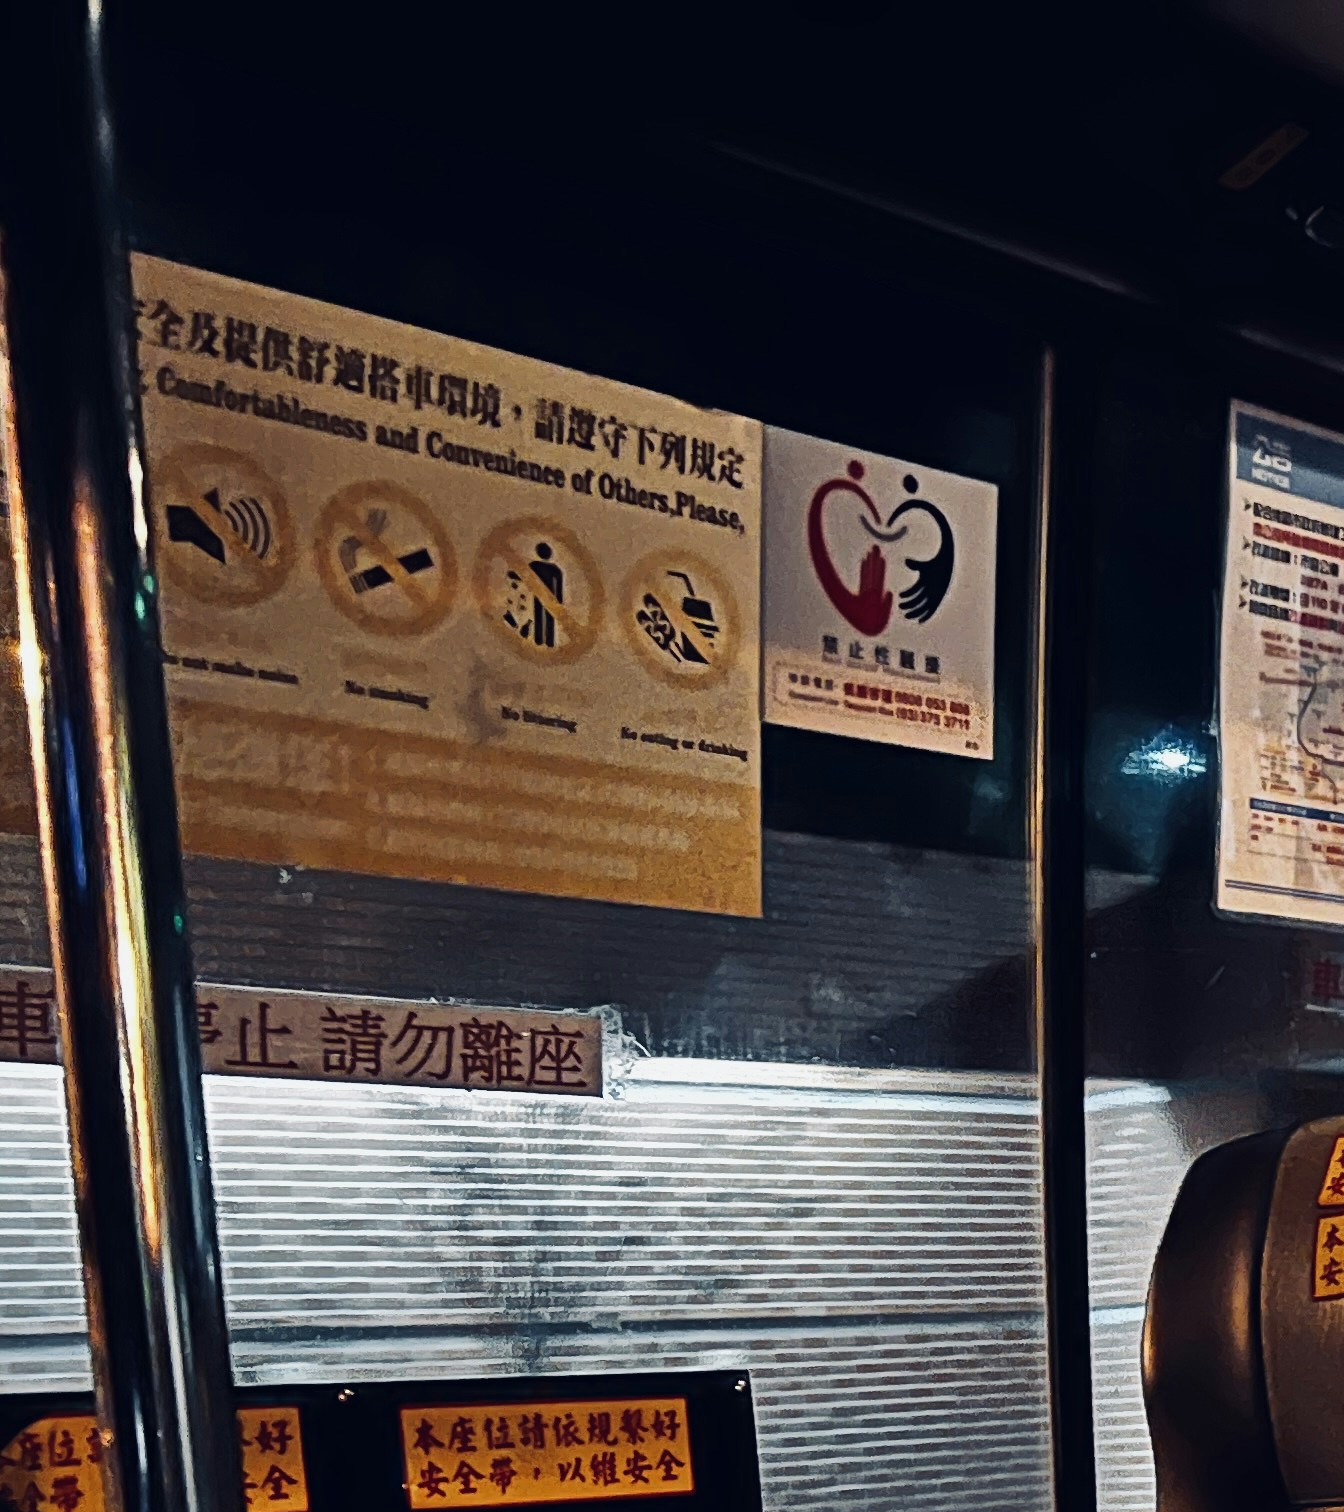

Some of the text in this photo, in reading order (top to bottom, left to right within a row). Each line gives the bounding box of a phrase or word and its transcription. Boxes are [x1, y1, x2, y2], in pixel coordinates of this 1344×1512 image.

[156, 366, 369, 442] Comfortableness
[376, 424, 419, 454] and
[426, 430, 565, 488] Convenience
[572, 468, 593, 495] of
[413, 1408, 681, 1456] 本座位請依規繫好
[417, 1448, 686, 1498] 安全帶，以維安全
